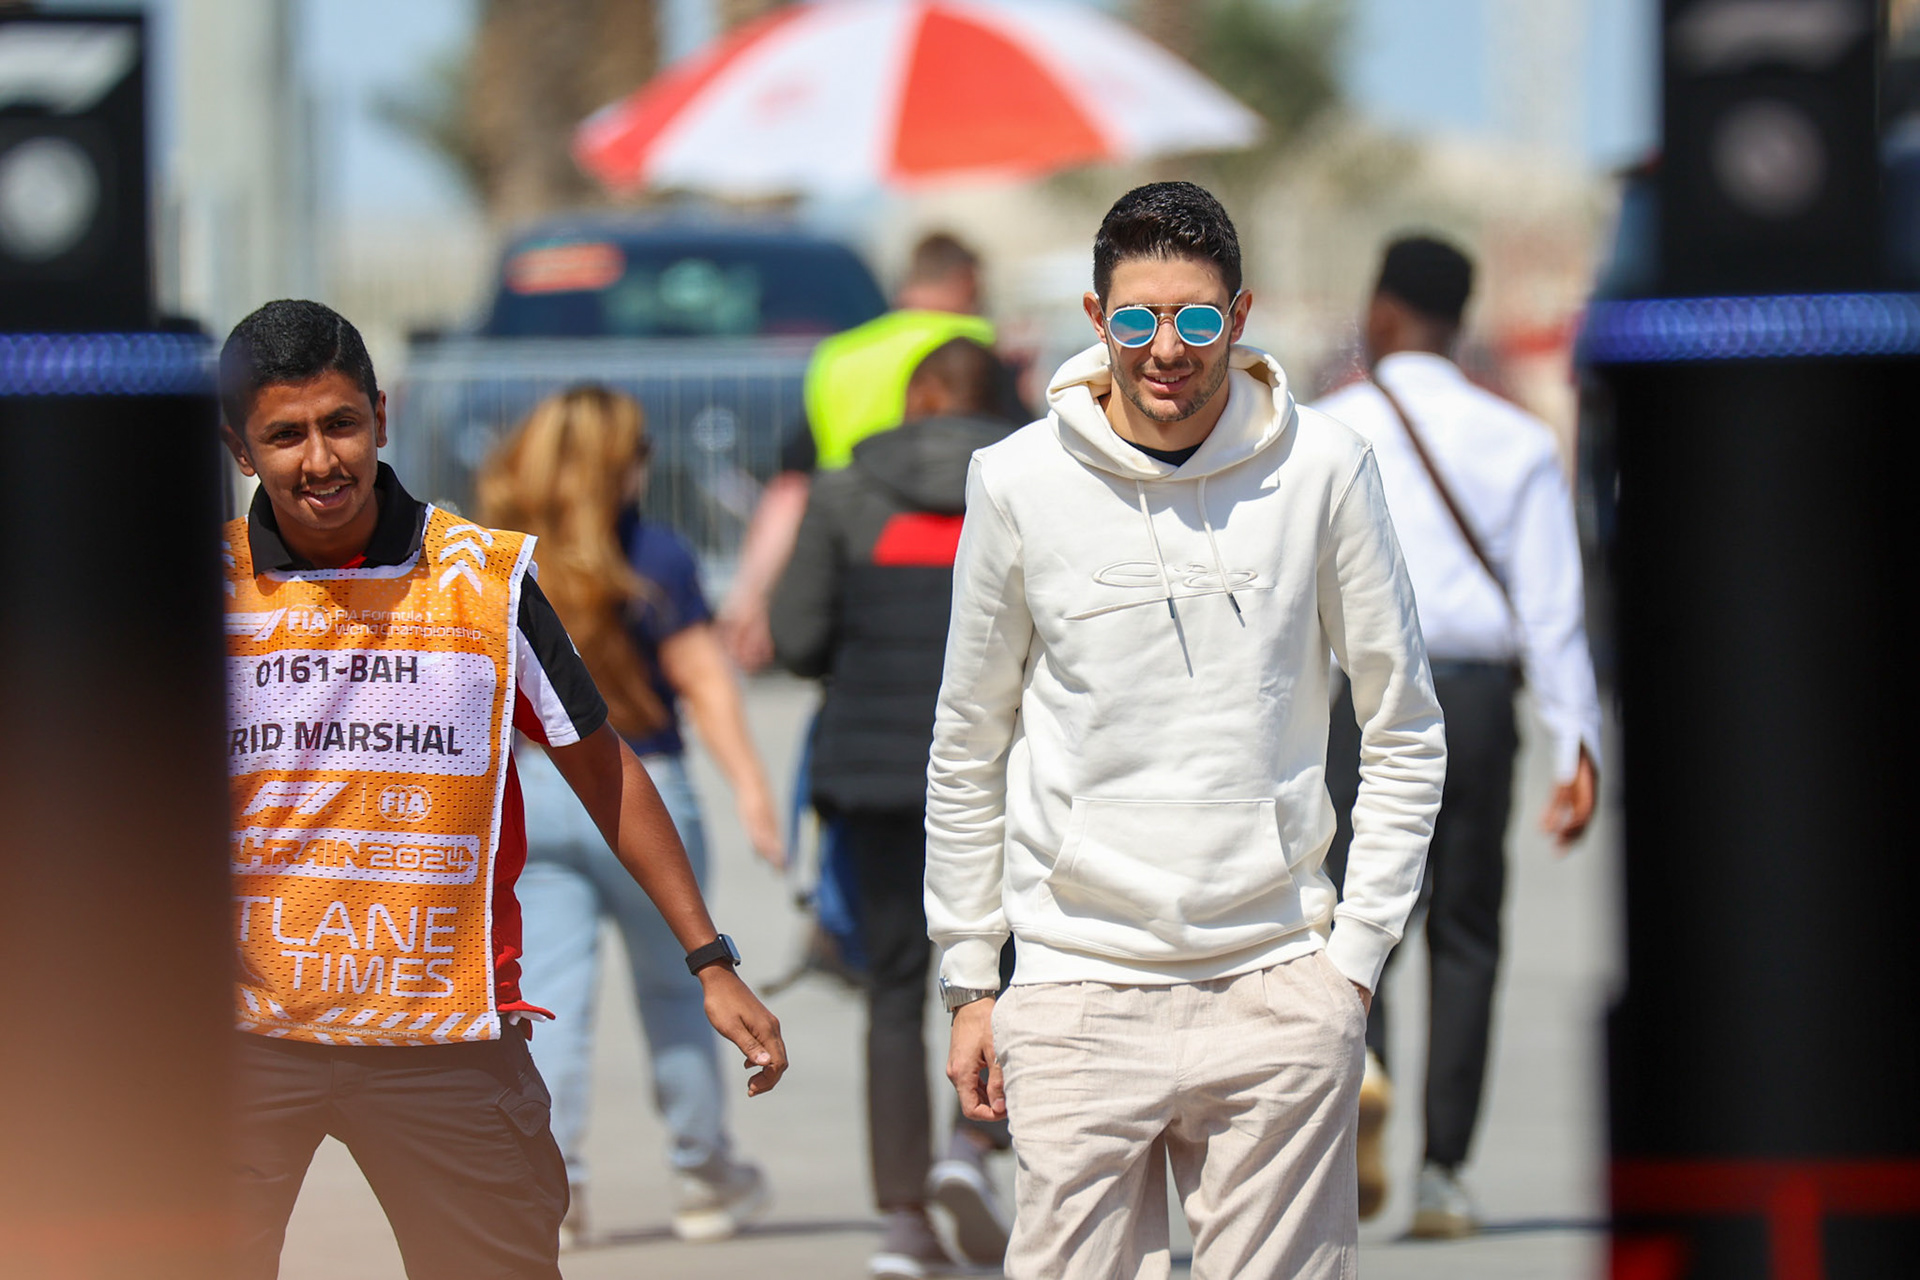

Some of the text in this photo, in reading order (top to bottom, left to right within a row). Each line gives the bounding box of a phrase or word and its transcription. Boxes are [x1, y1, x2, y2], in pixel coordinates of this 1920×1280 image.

[361, 609, 424, 623] Formula
[380, 623, 482, 641] Championship
[256, 655, 418, 687] 0161-BAH
[229, 721, 463, 756] RID MARSHAL
[241, 781, 350, 816] F1
[367, 844, 472, 871] 2024
[231, 895, 458, 954] TLANE
[280, 950, 455, 998] TIMES
